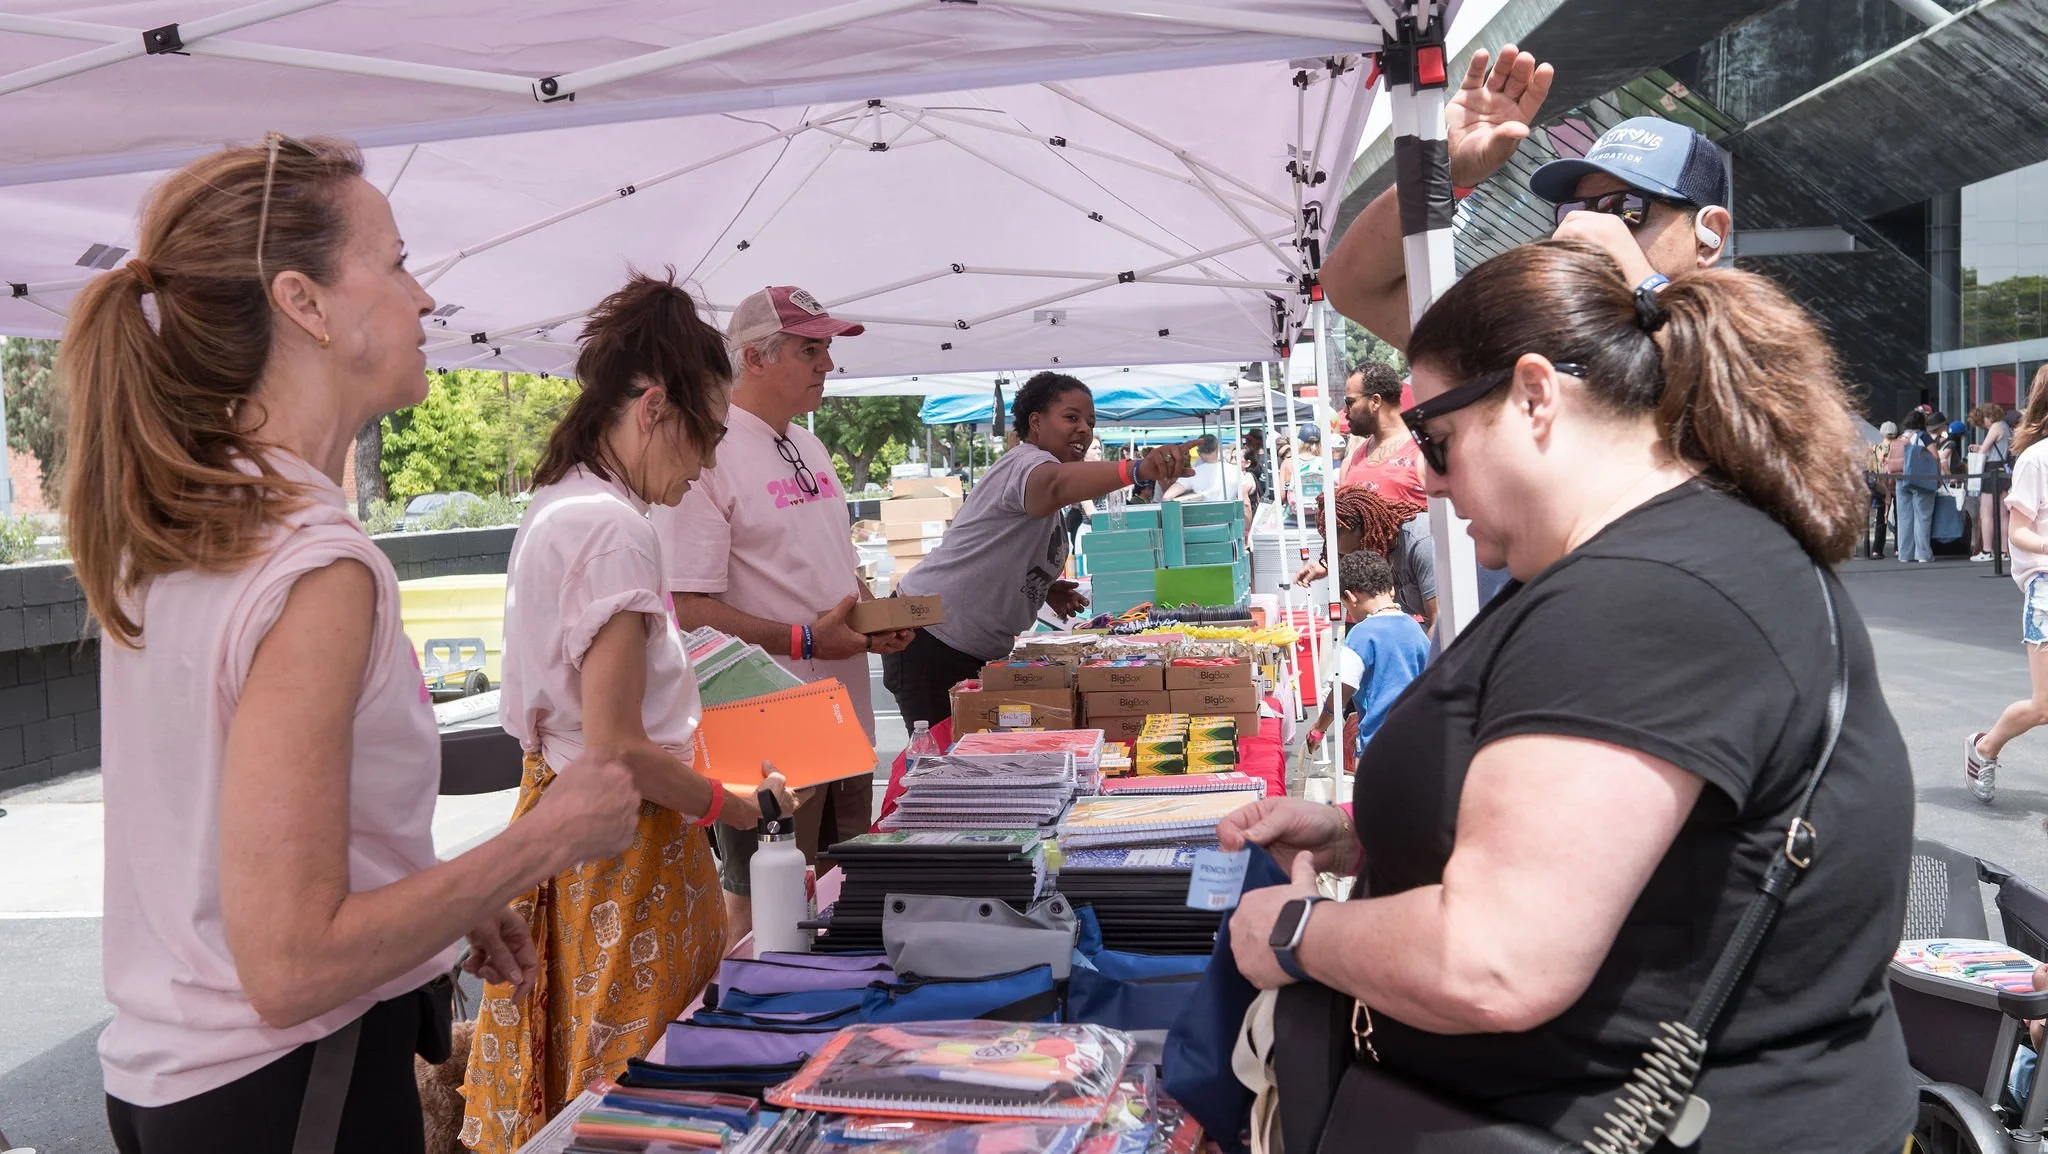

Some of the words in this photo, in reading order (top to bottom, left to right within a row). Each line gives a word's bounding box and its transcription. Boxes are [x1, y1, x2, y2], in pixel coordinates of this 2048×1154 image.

[911, 604, 931, 616] BigBox
[1014, 673, 1043, 684] BigBox
[1111, 673, 1141, 684] BigBox
[1200, 671, 1230, 681] BigBox
[1120, 698, 1149, 708] BigBox
[1204, 695, 1235, 706] BigBox
